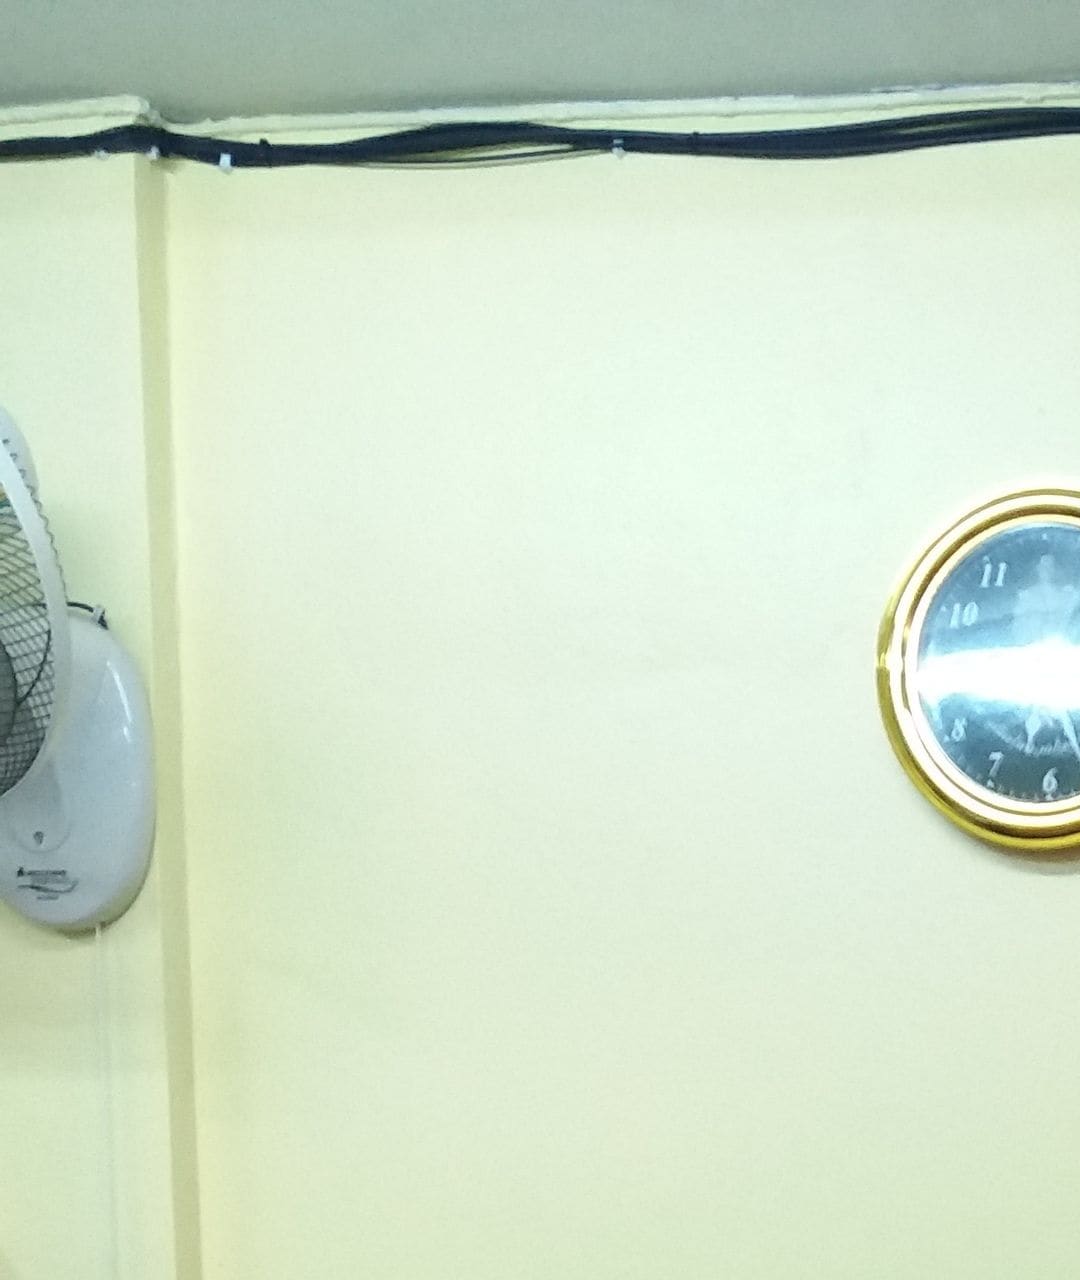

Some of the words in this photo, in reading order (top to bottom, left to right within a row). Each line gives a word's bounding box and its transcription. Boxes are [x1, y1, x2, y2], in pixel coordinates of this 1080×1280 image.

[980, 561, 1008, 588] 11
[950, 601, 979, 629] 10
[988, 750, 1005, 777] 7
[1042, 766, 1058, 794] 6
